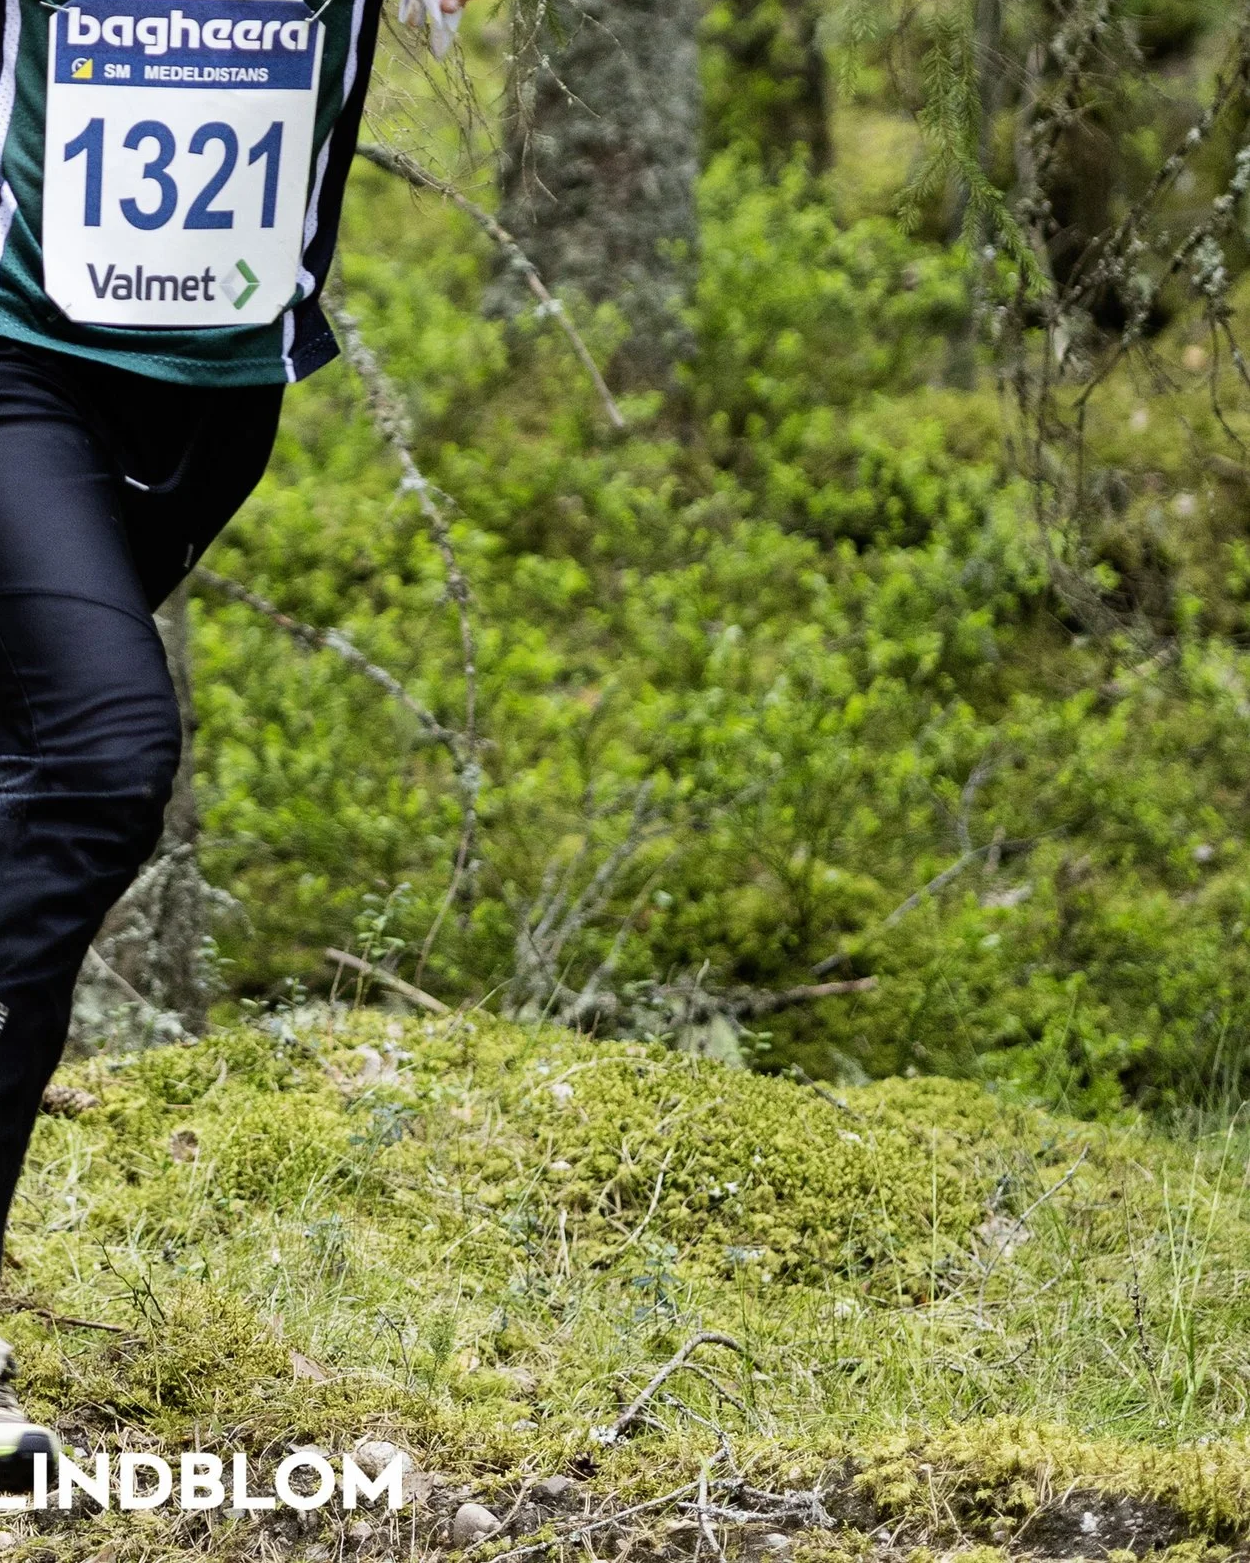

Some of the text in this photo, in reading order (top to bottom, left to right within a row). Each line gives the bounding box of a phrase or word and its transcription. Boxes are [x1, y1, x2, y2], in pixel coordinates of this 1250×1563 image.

[67, 6, 309, 55] bagheera
[103, 63, 269, 82] SM MEDELDISTANS
[63, 116, 285, 231] 1321
[86, 262, 216, 302] Valmet
